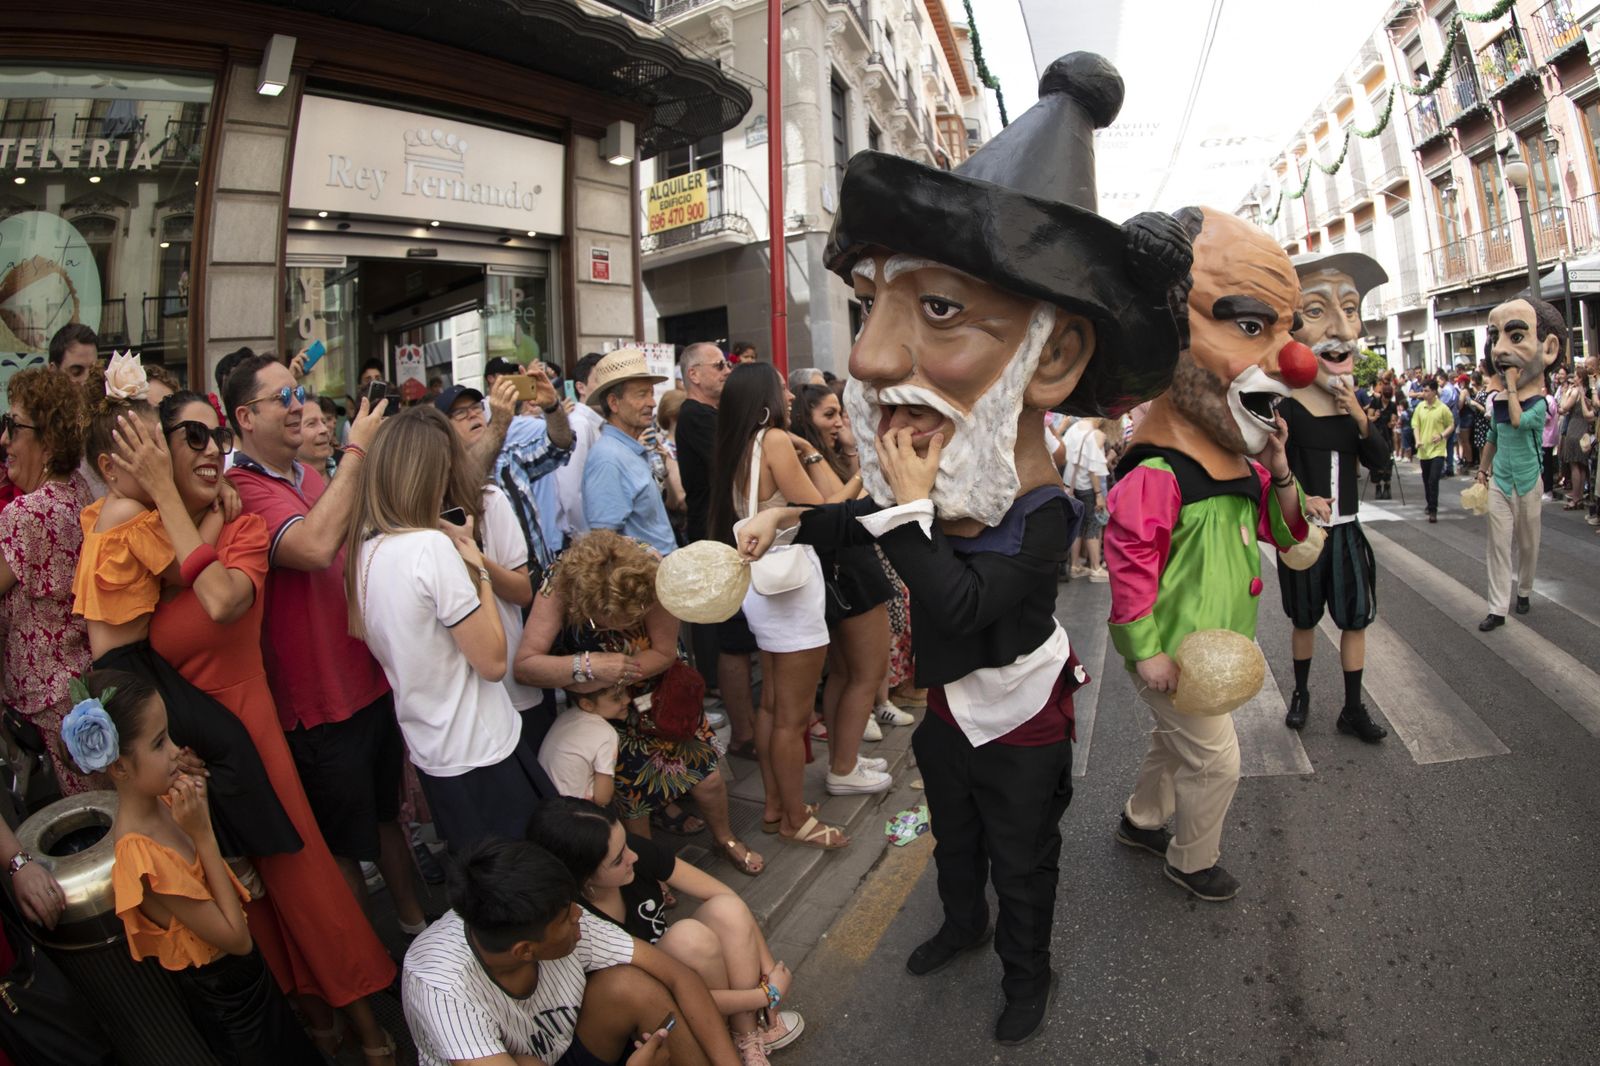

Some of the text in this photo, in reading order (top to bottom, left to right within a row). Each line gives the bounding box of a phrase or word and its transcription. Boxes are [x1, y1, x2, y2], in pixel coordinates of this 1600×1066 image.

[325, 154, 535, 212] Rey Fernando
[649, 173, 703, 202] ALQUILER
[649, 202, 705, 231] 696 470 900
[659, 194, 692, 210] EDIFICIO
[0, 232, 88, 286] assata
